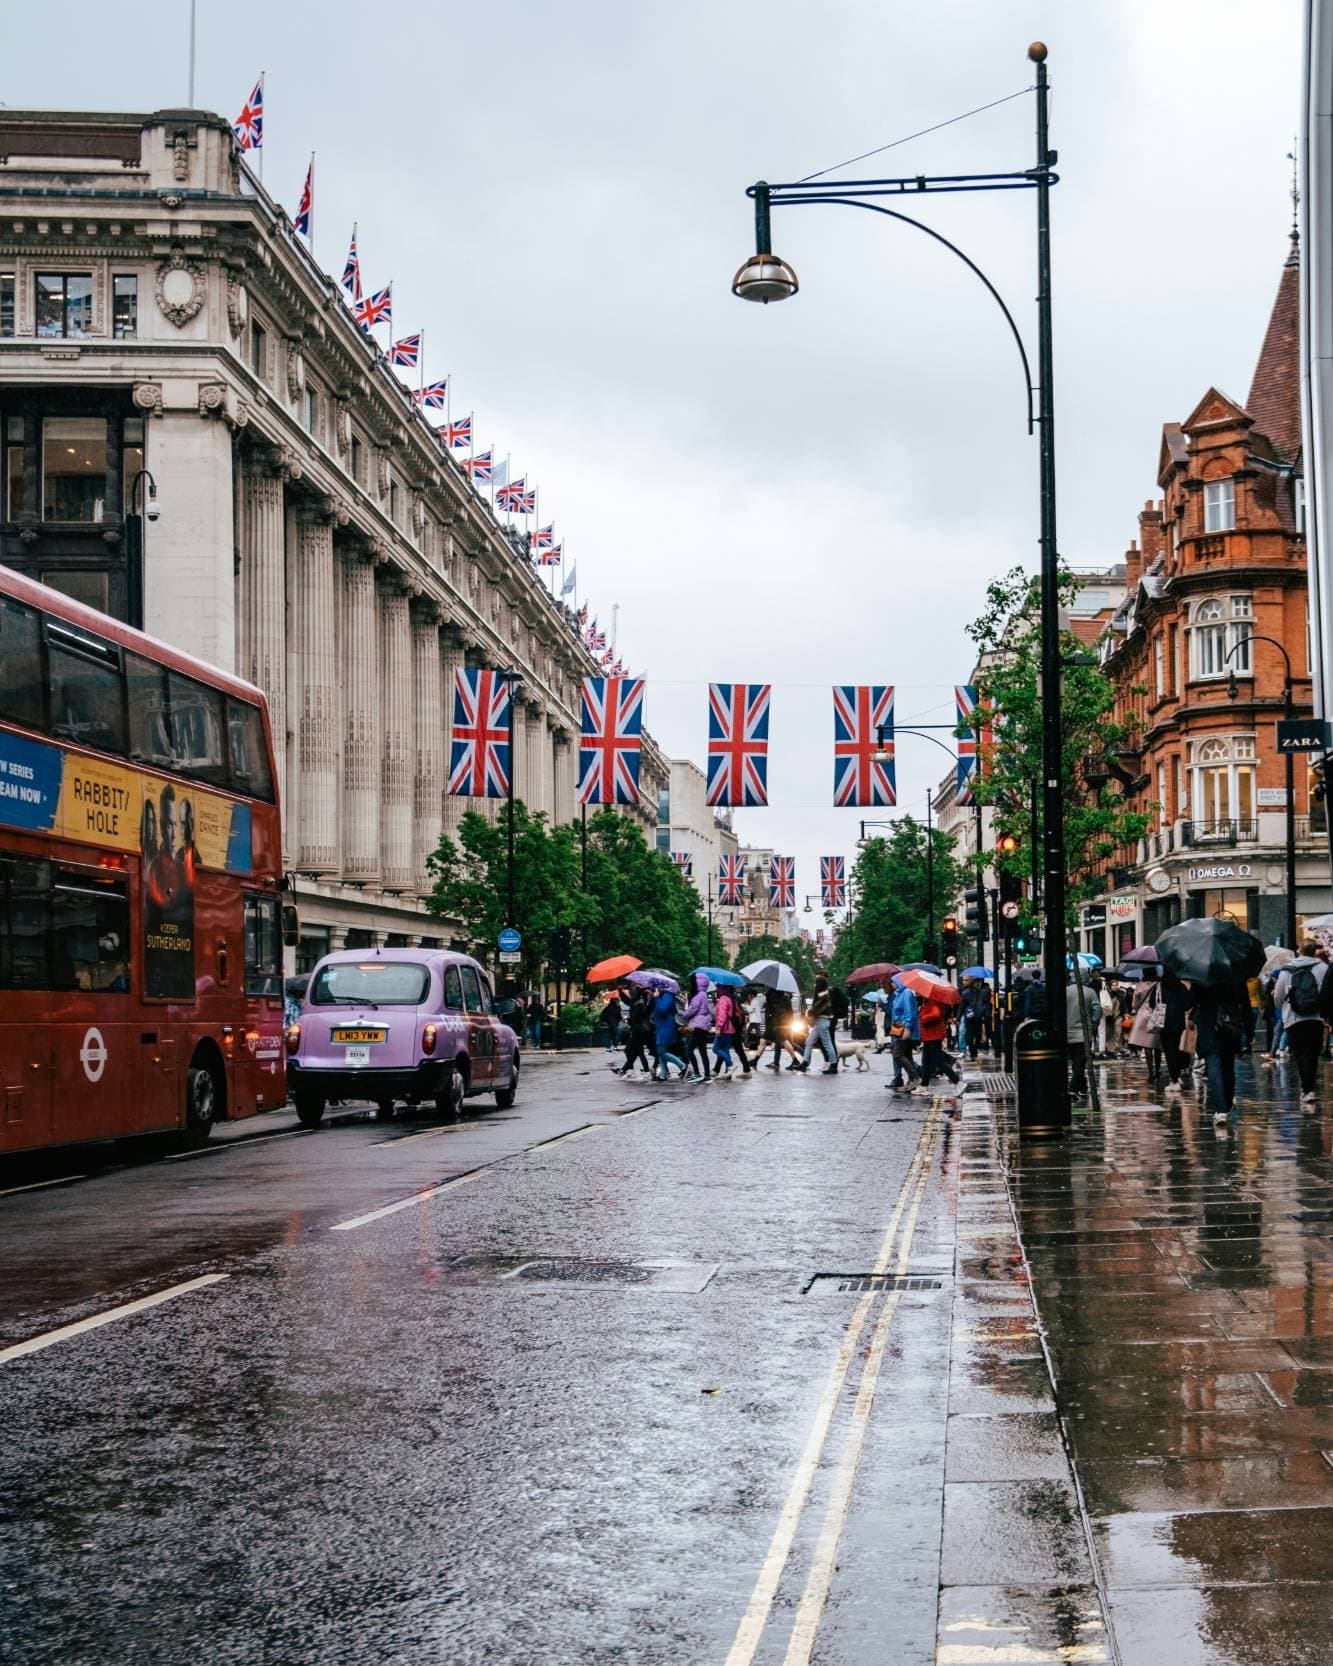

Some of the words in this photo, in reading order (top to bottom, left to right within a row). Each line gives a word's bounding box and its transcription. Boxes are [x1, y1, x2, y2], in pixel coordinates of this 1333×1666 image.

[1282, 738, 1321, 747] ZARA
[9, 762, 34, 780] SERIES
[20, 786, 41, 804] NOW
[87, 808, 119, 836] HOLE
[1197, 867, 1234, 878] OMEGA
[147, 935, 191, 951] SUTHERLAND
